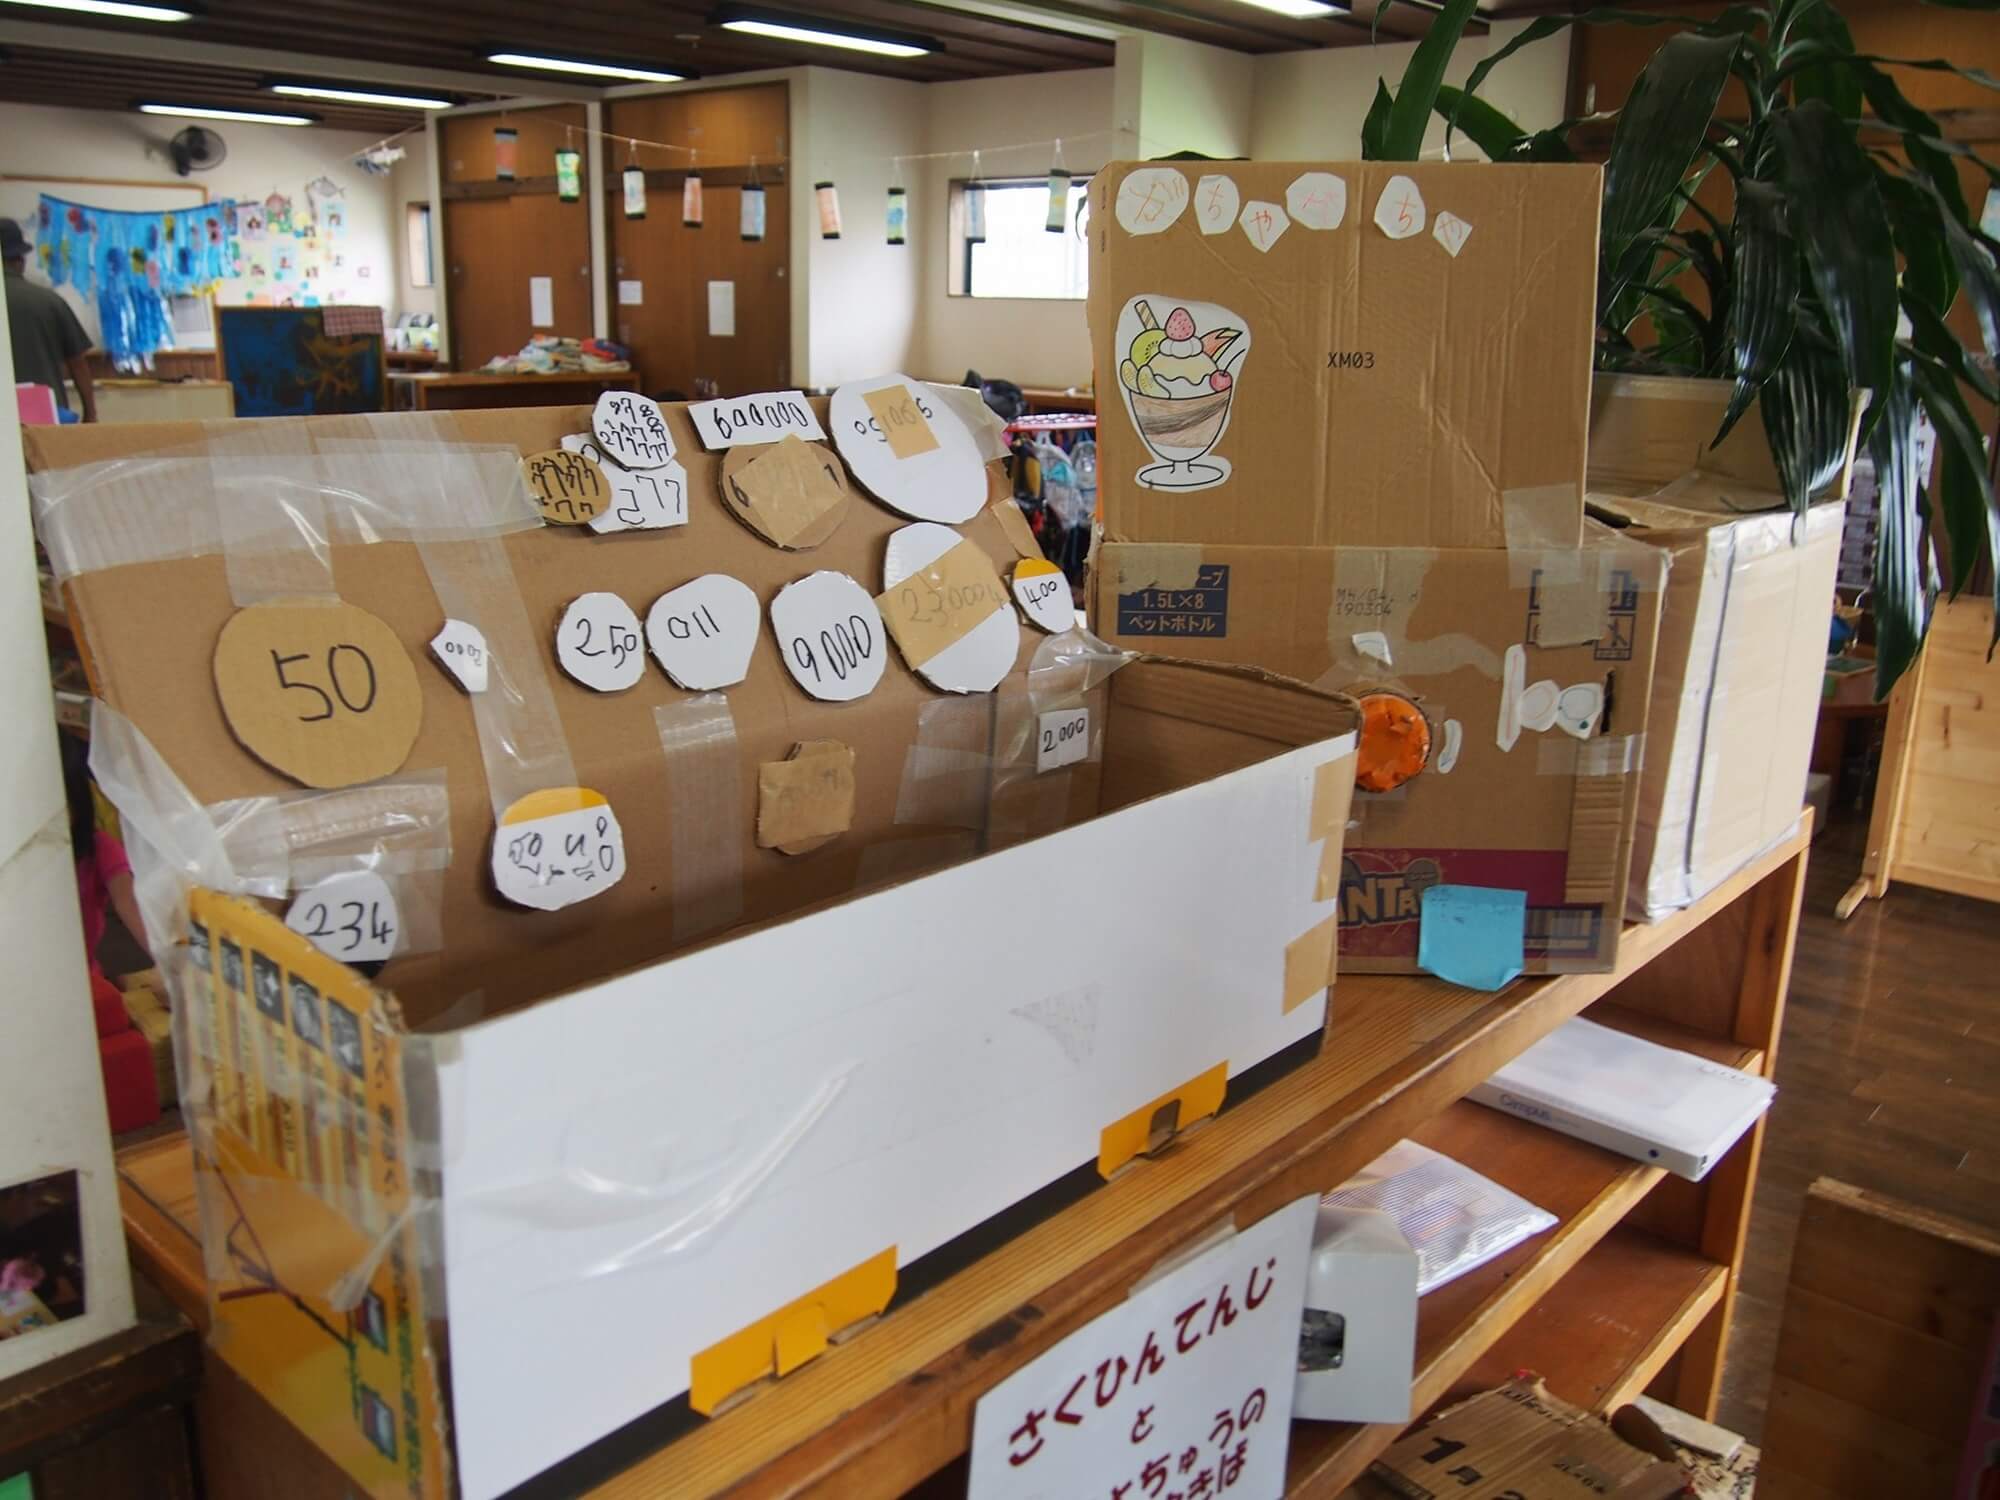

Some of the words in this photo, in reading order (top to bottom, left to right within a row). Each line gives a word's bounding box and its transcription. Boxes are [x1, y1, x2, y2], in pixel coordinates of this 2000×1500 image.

[1327, 351, 1376, 370] XM03
[1023, 580, 1058, 611] 400
[576, 618, 637, 669] 250
[794, 614, 872, 683] 9000
[1128, 615, 1216, 632] ペットボトル
[270, 642, 377, 722] 50
[304, 901, 394, 951] 234
[1008, 1257, 1277, 1468] さくひんてんじ
[1130, 1404, 1156, 1445] と
